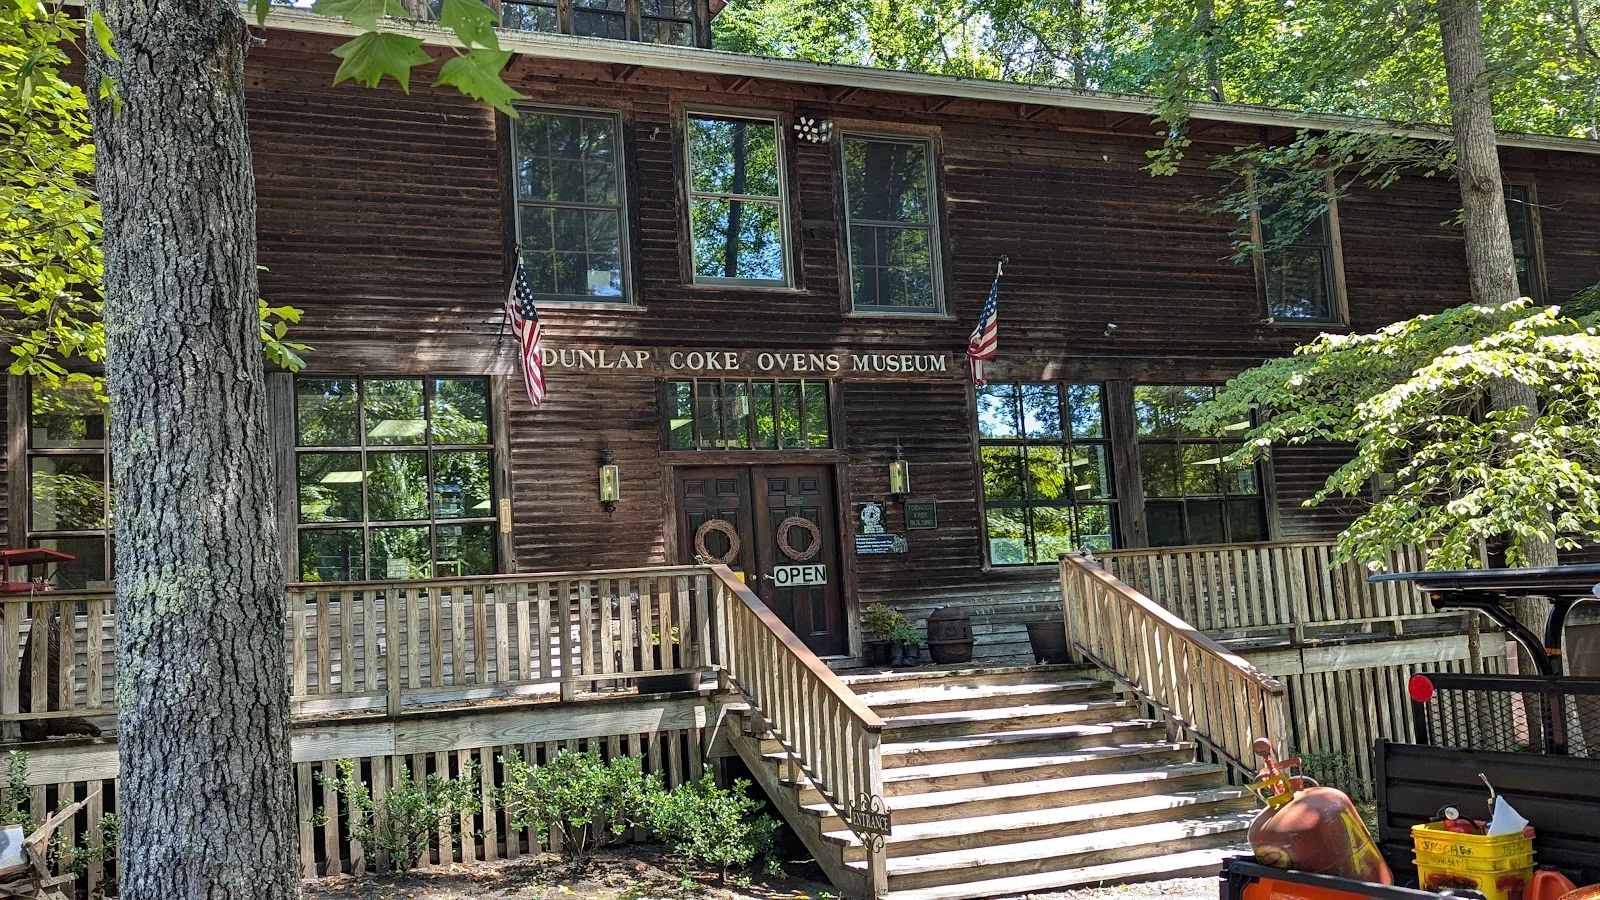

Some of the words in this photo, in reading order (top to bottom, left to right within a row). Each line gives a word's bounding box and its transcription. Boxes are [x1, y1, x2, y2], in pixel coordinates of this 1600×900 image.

[541, 348, 650, 369] DUNLAP
[669, 351, 740, 370] COKE
[757, 352, 840, 372] OVENS
[851, 354, 947, 372] MUSEUM
[908, 504, 934, 512] TOBACCO
[913, 511, 929, 519] FREE
[909, 519, 934, 527] BUILDING
[775, 566, 826, 584] OPEN
[852, 811, 889, 831] ENTRANCE
